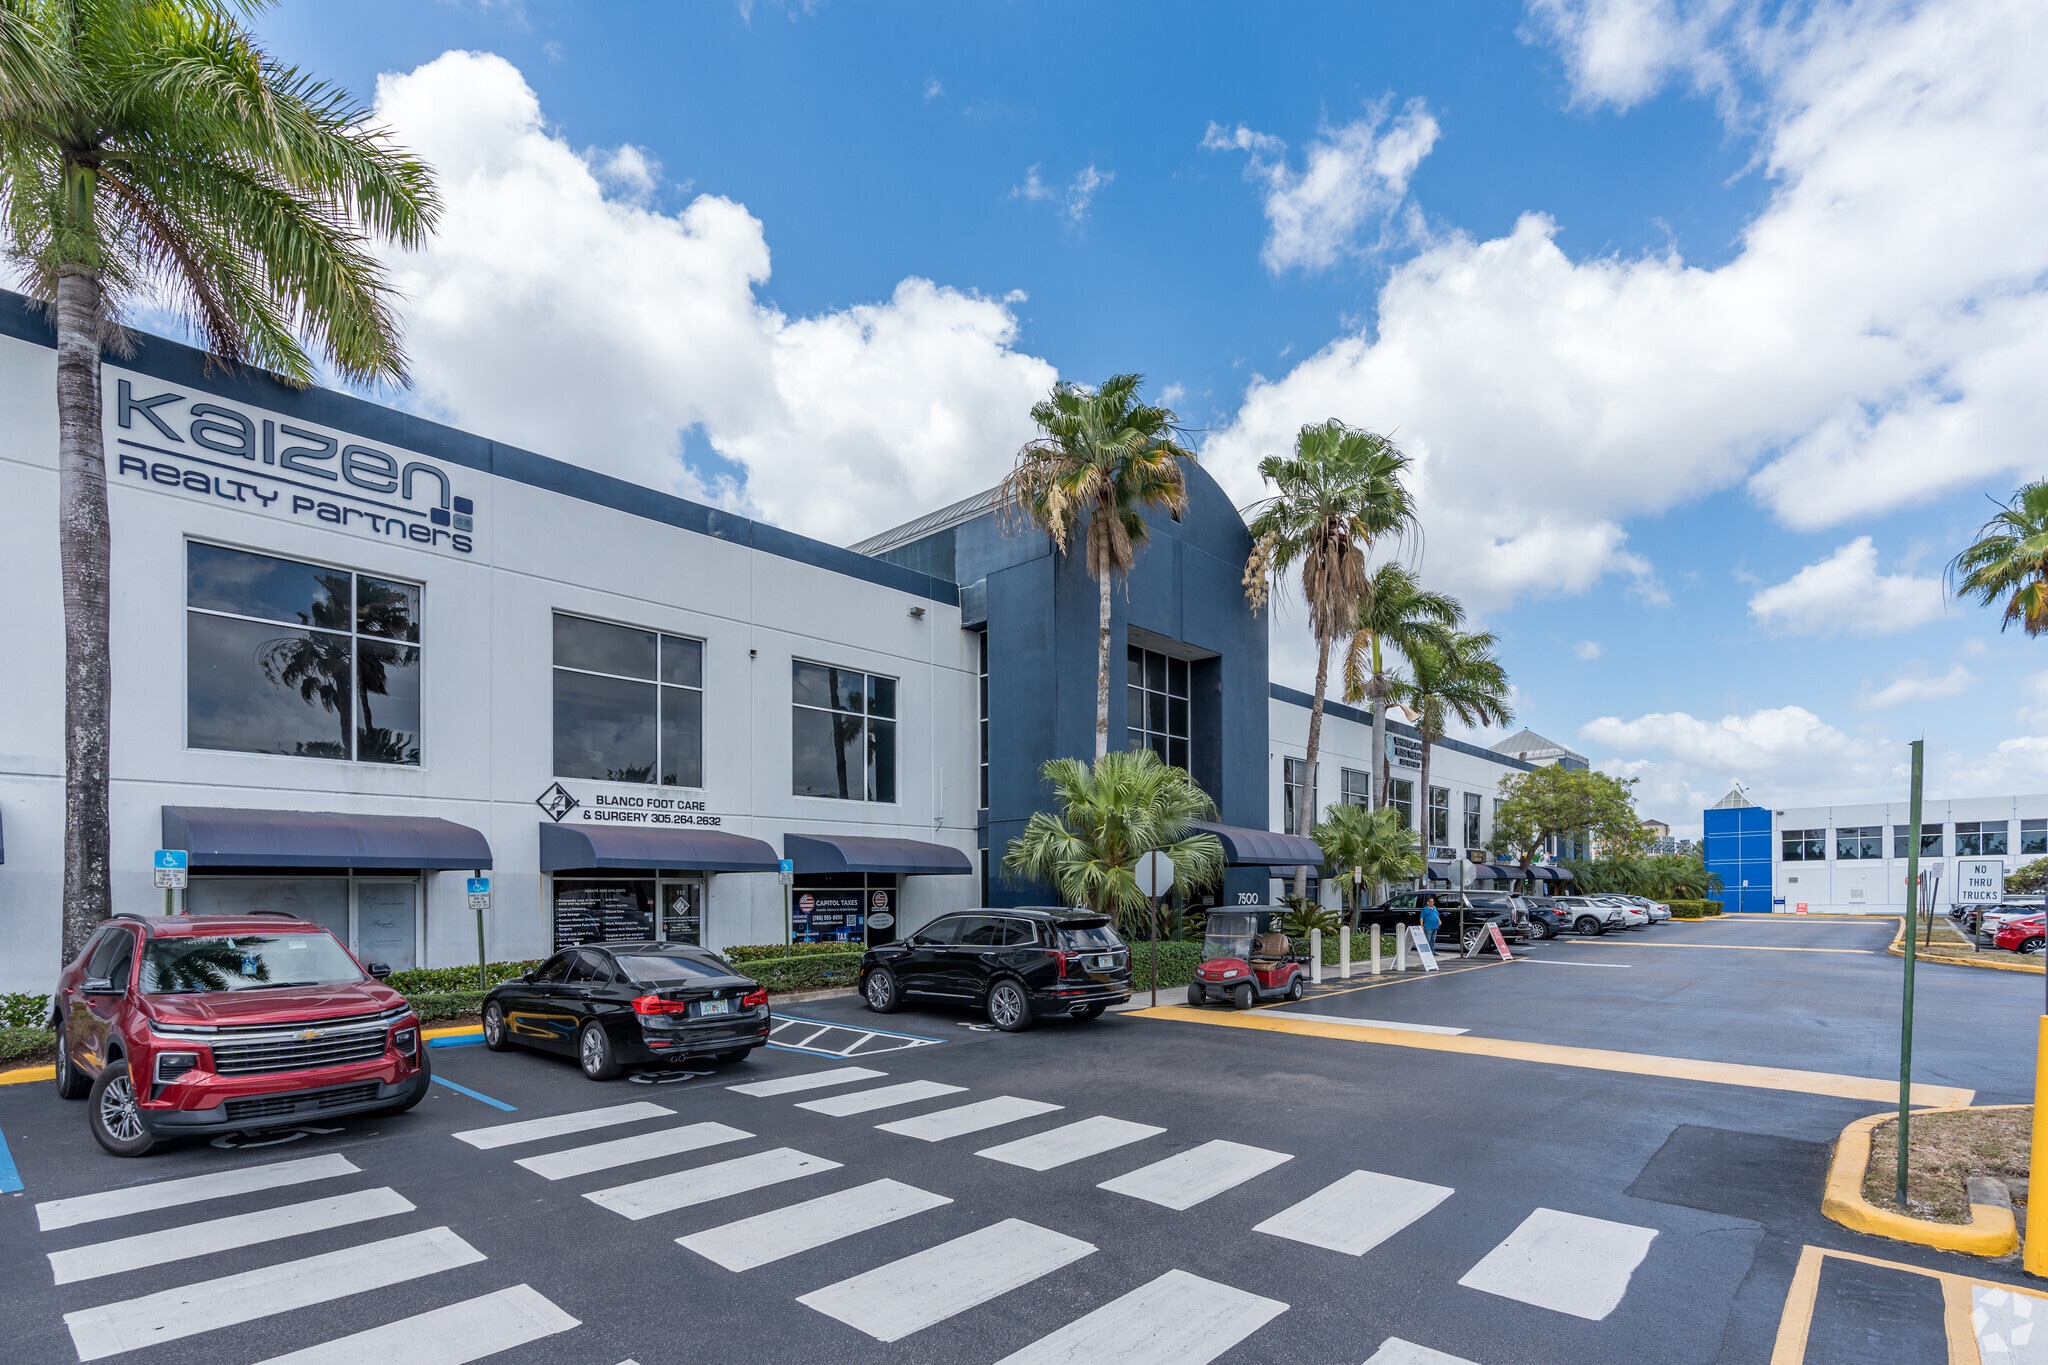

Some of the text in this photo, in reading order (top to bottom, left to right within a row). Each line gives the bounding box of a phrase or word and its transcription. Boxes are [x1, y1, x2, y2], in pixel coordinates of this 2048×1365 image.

[596, 795, 706, 811] BLANCO FOOT CARE
[583, 810, 721, 826] & SURGERY 305.264.2632
[1974, 866, 1987, 874] NO
[1969, 878, 1992, 887] THRU
[1238, 893, 1258, 904] 7500
[1963, 891, 1998, 900] TRUCKS
[837, 932, 848, 941] TAX
